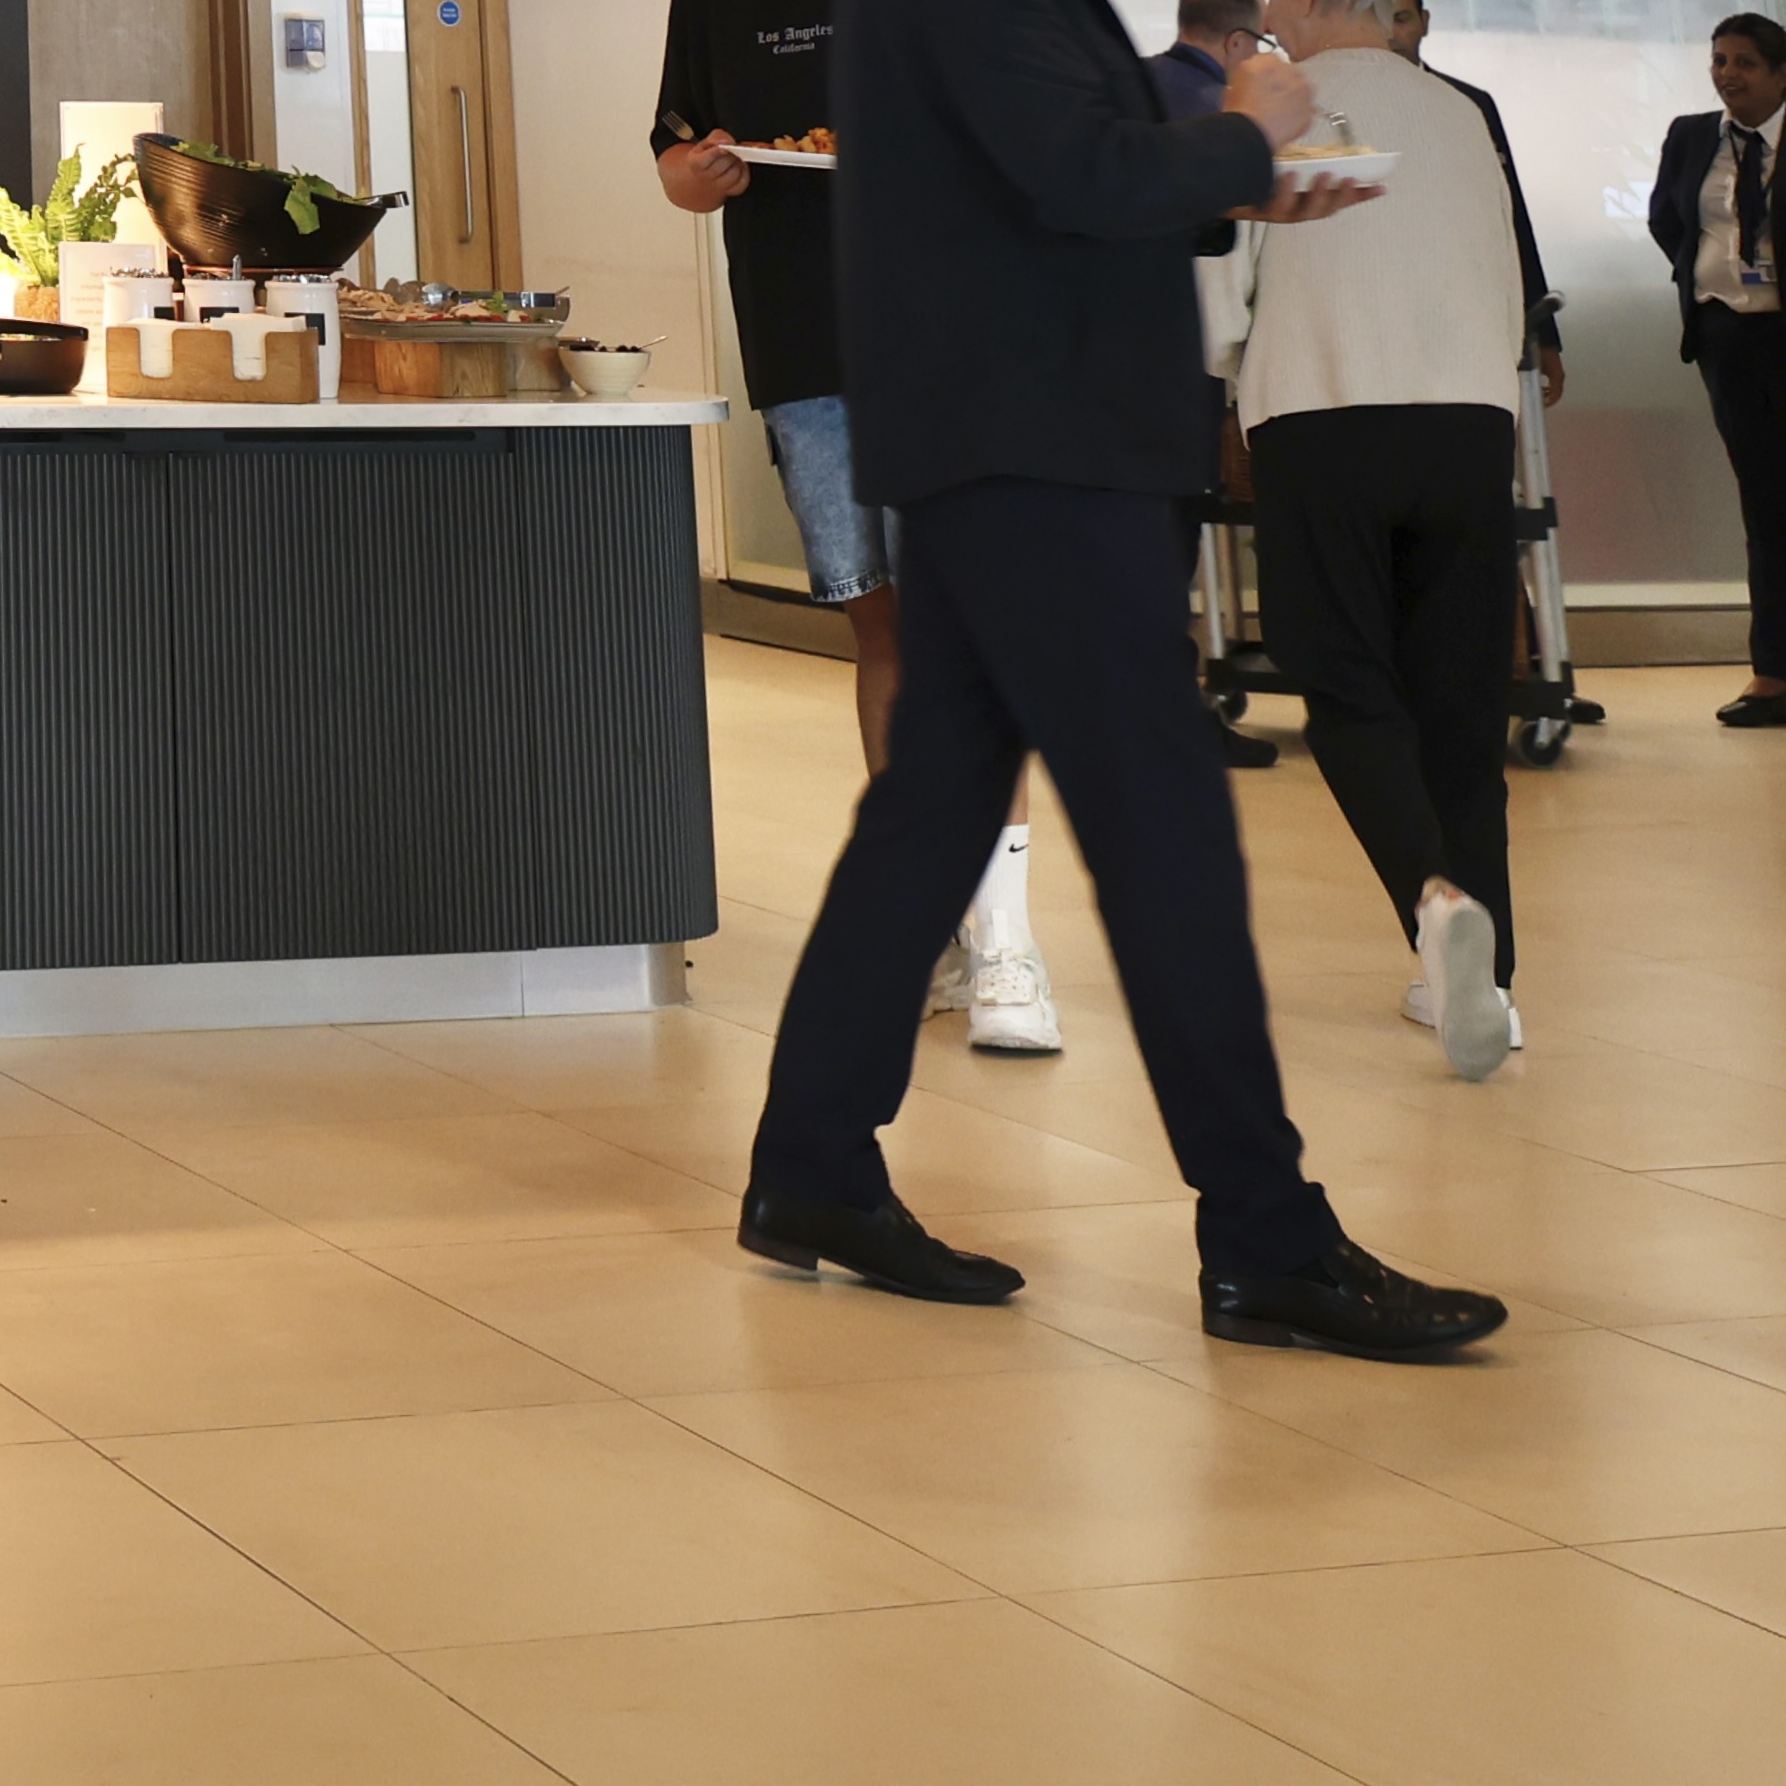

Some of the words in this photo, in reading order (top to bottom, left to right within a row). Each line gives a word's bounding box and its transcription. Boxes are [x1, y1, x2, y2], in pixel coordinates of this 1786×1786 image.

[757, 31, 779, 43] Los
[784, 23, 833, 40] Angeles
[772, 41, 815, 54] California
